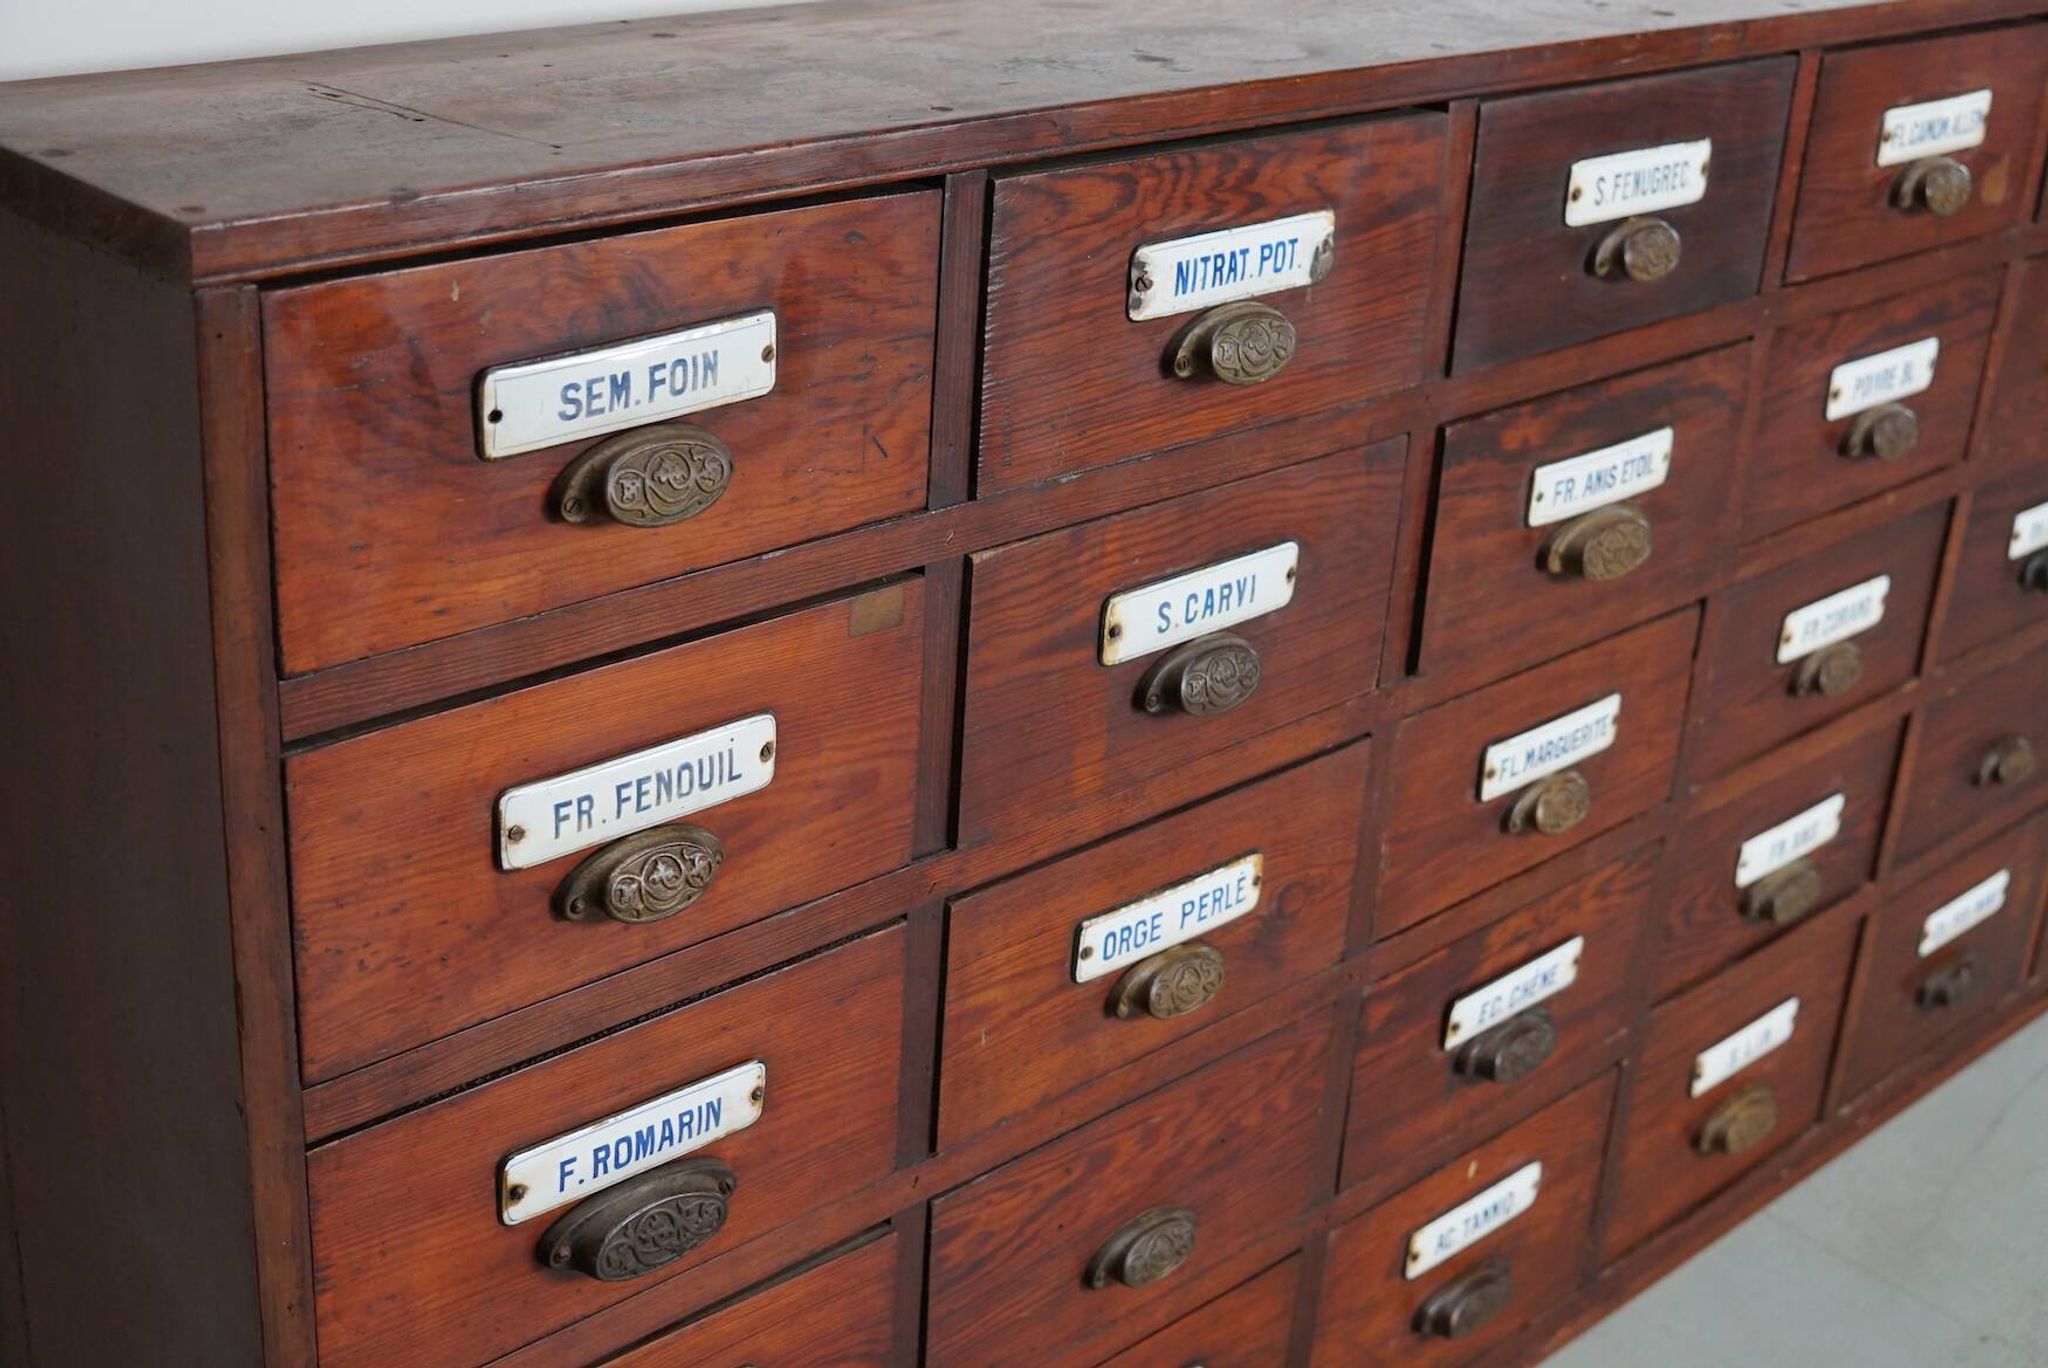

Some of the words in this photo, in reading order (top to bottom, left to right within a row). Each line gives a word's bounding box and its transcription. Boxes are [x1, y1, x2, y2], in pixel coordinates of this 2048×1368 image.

[1184, 573, 1256, 625] CARVI
[615, 747, 744, 820] FENOUIL
[1102, 911, 1163, 961] ORGE
[592, 1096, 722, 1180] ROMARIN
